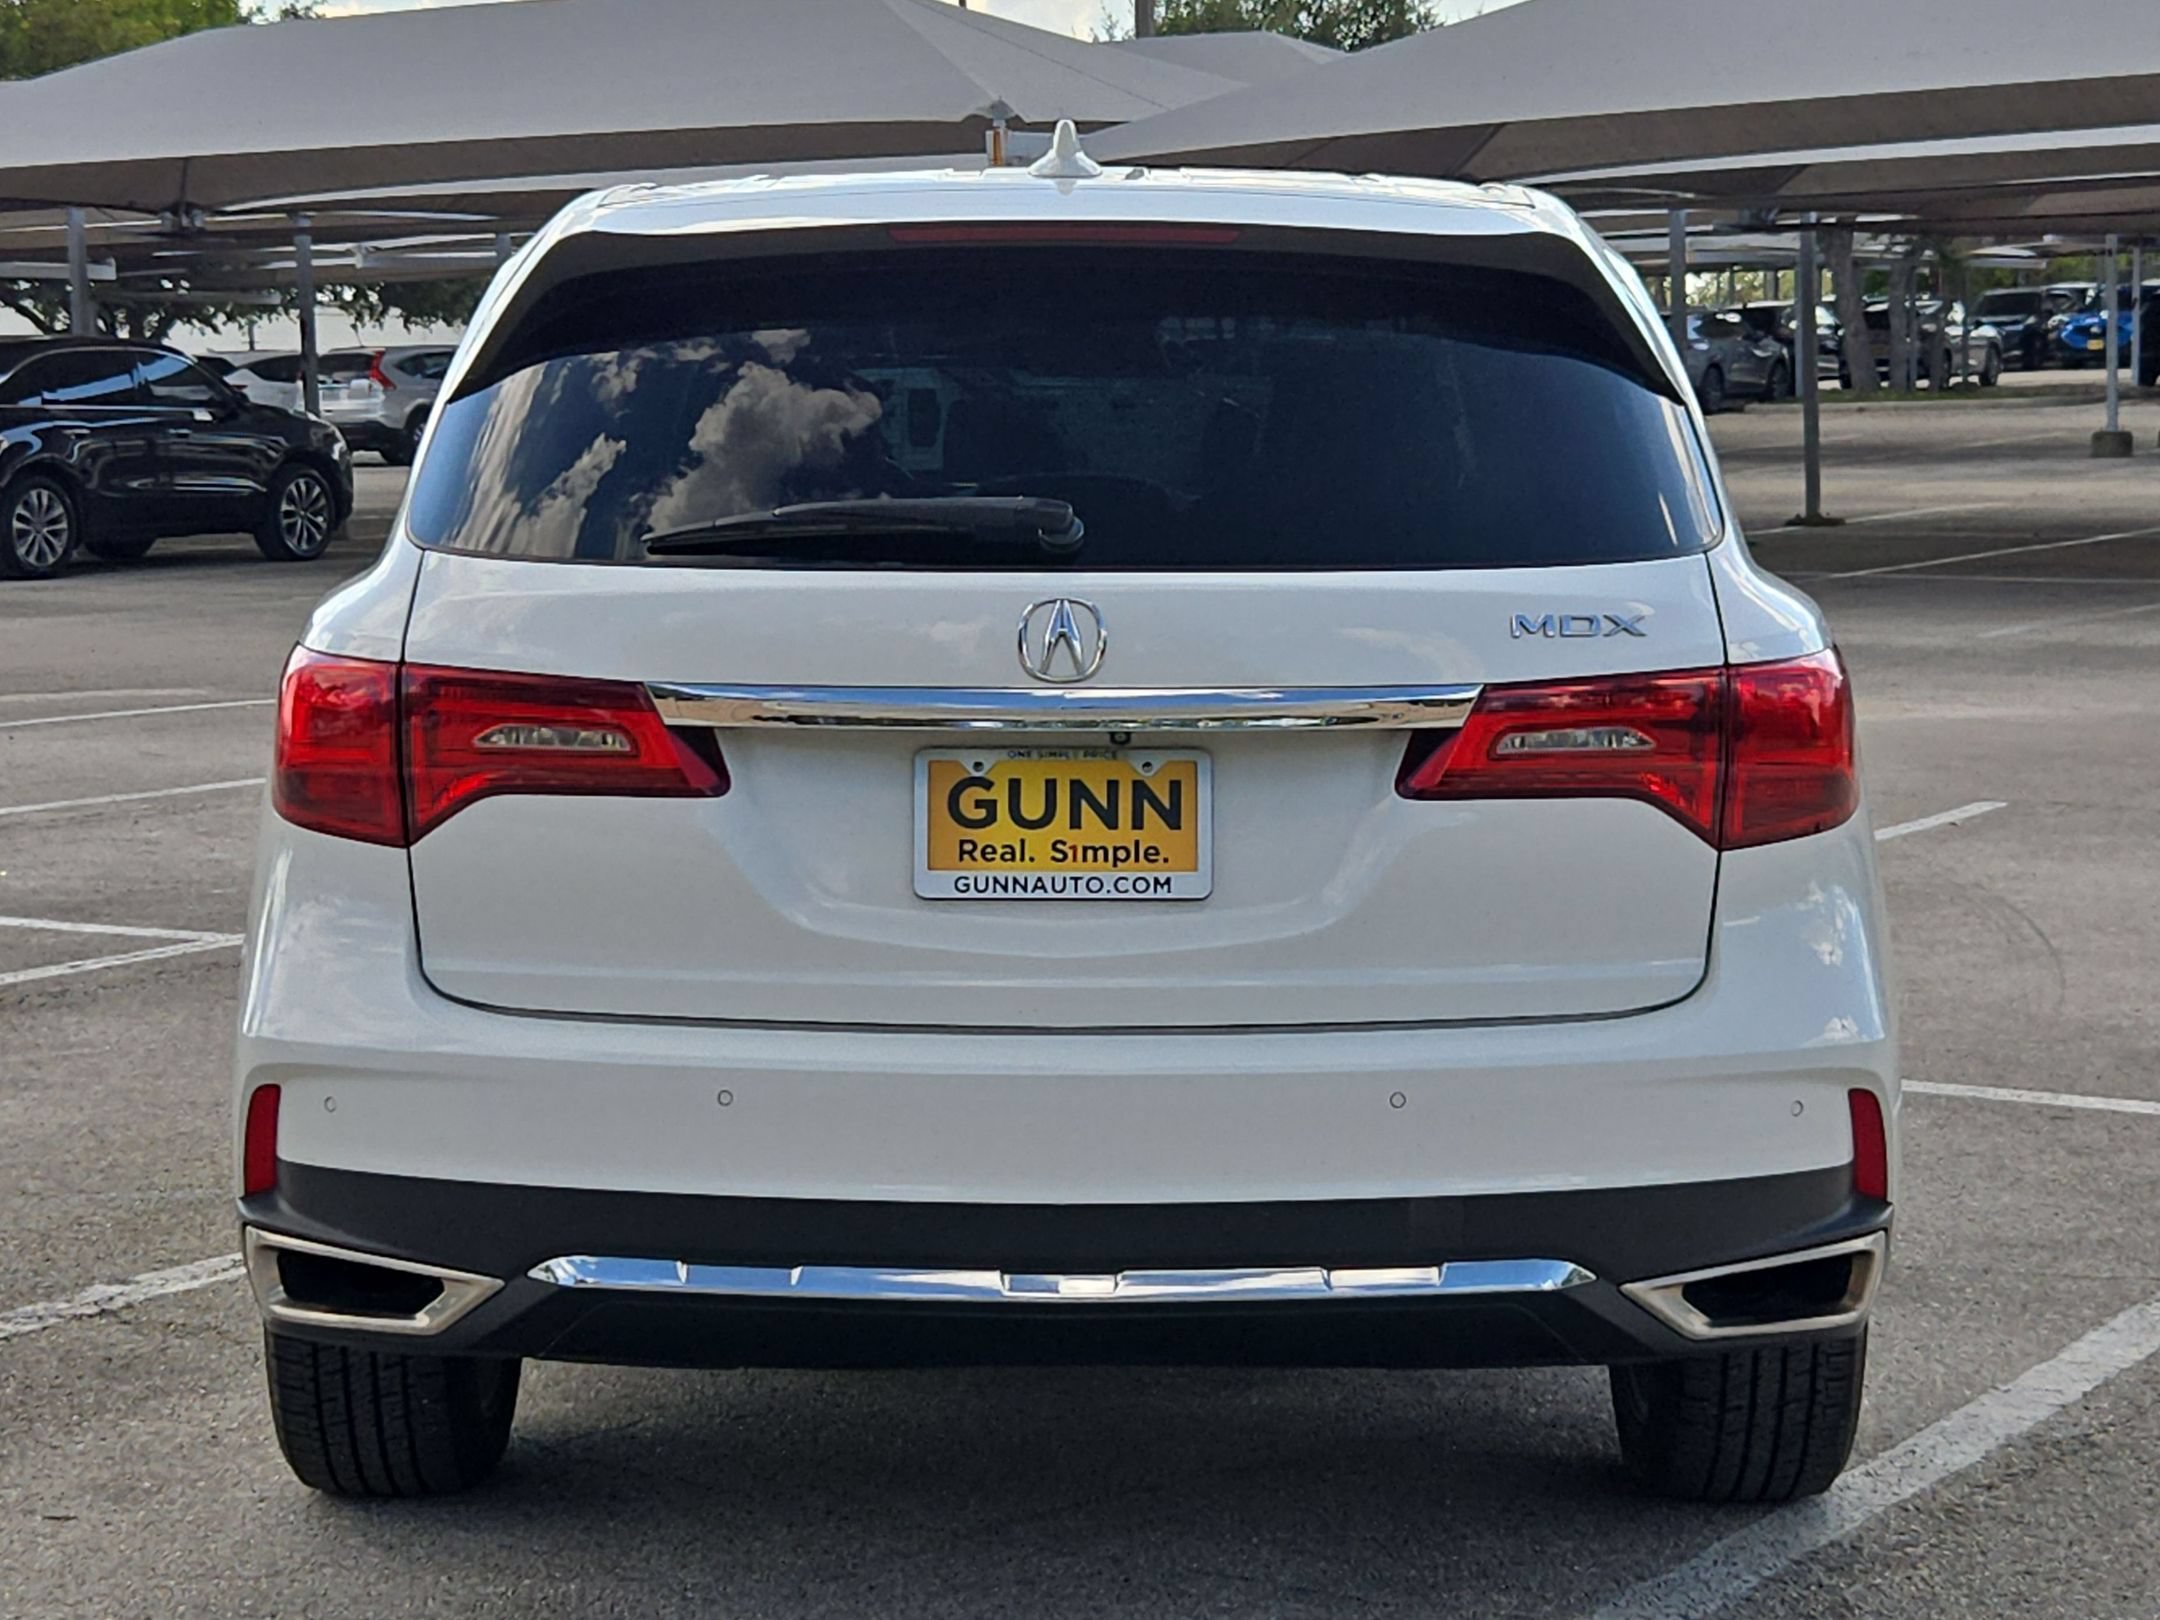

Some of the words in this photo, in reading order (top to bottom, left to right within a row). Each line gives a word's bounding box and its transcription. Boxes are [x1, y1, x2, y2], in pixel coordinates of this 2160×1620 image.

[1510, 614, 1648, 638] MDX
[1007, 750, 1032, 759] ONE
[947, 776, 1182, 830] GUNN
[958, 838, 1035, 863] Real.
[954, 876, 1172, 894] GUNNAUTO.COM
